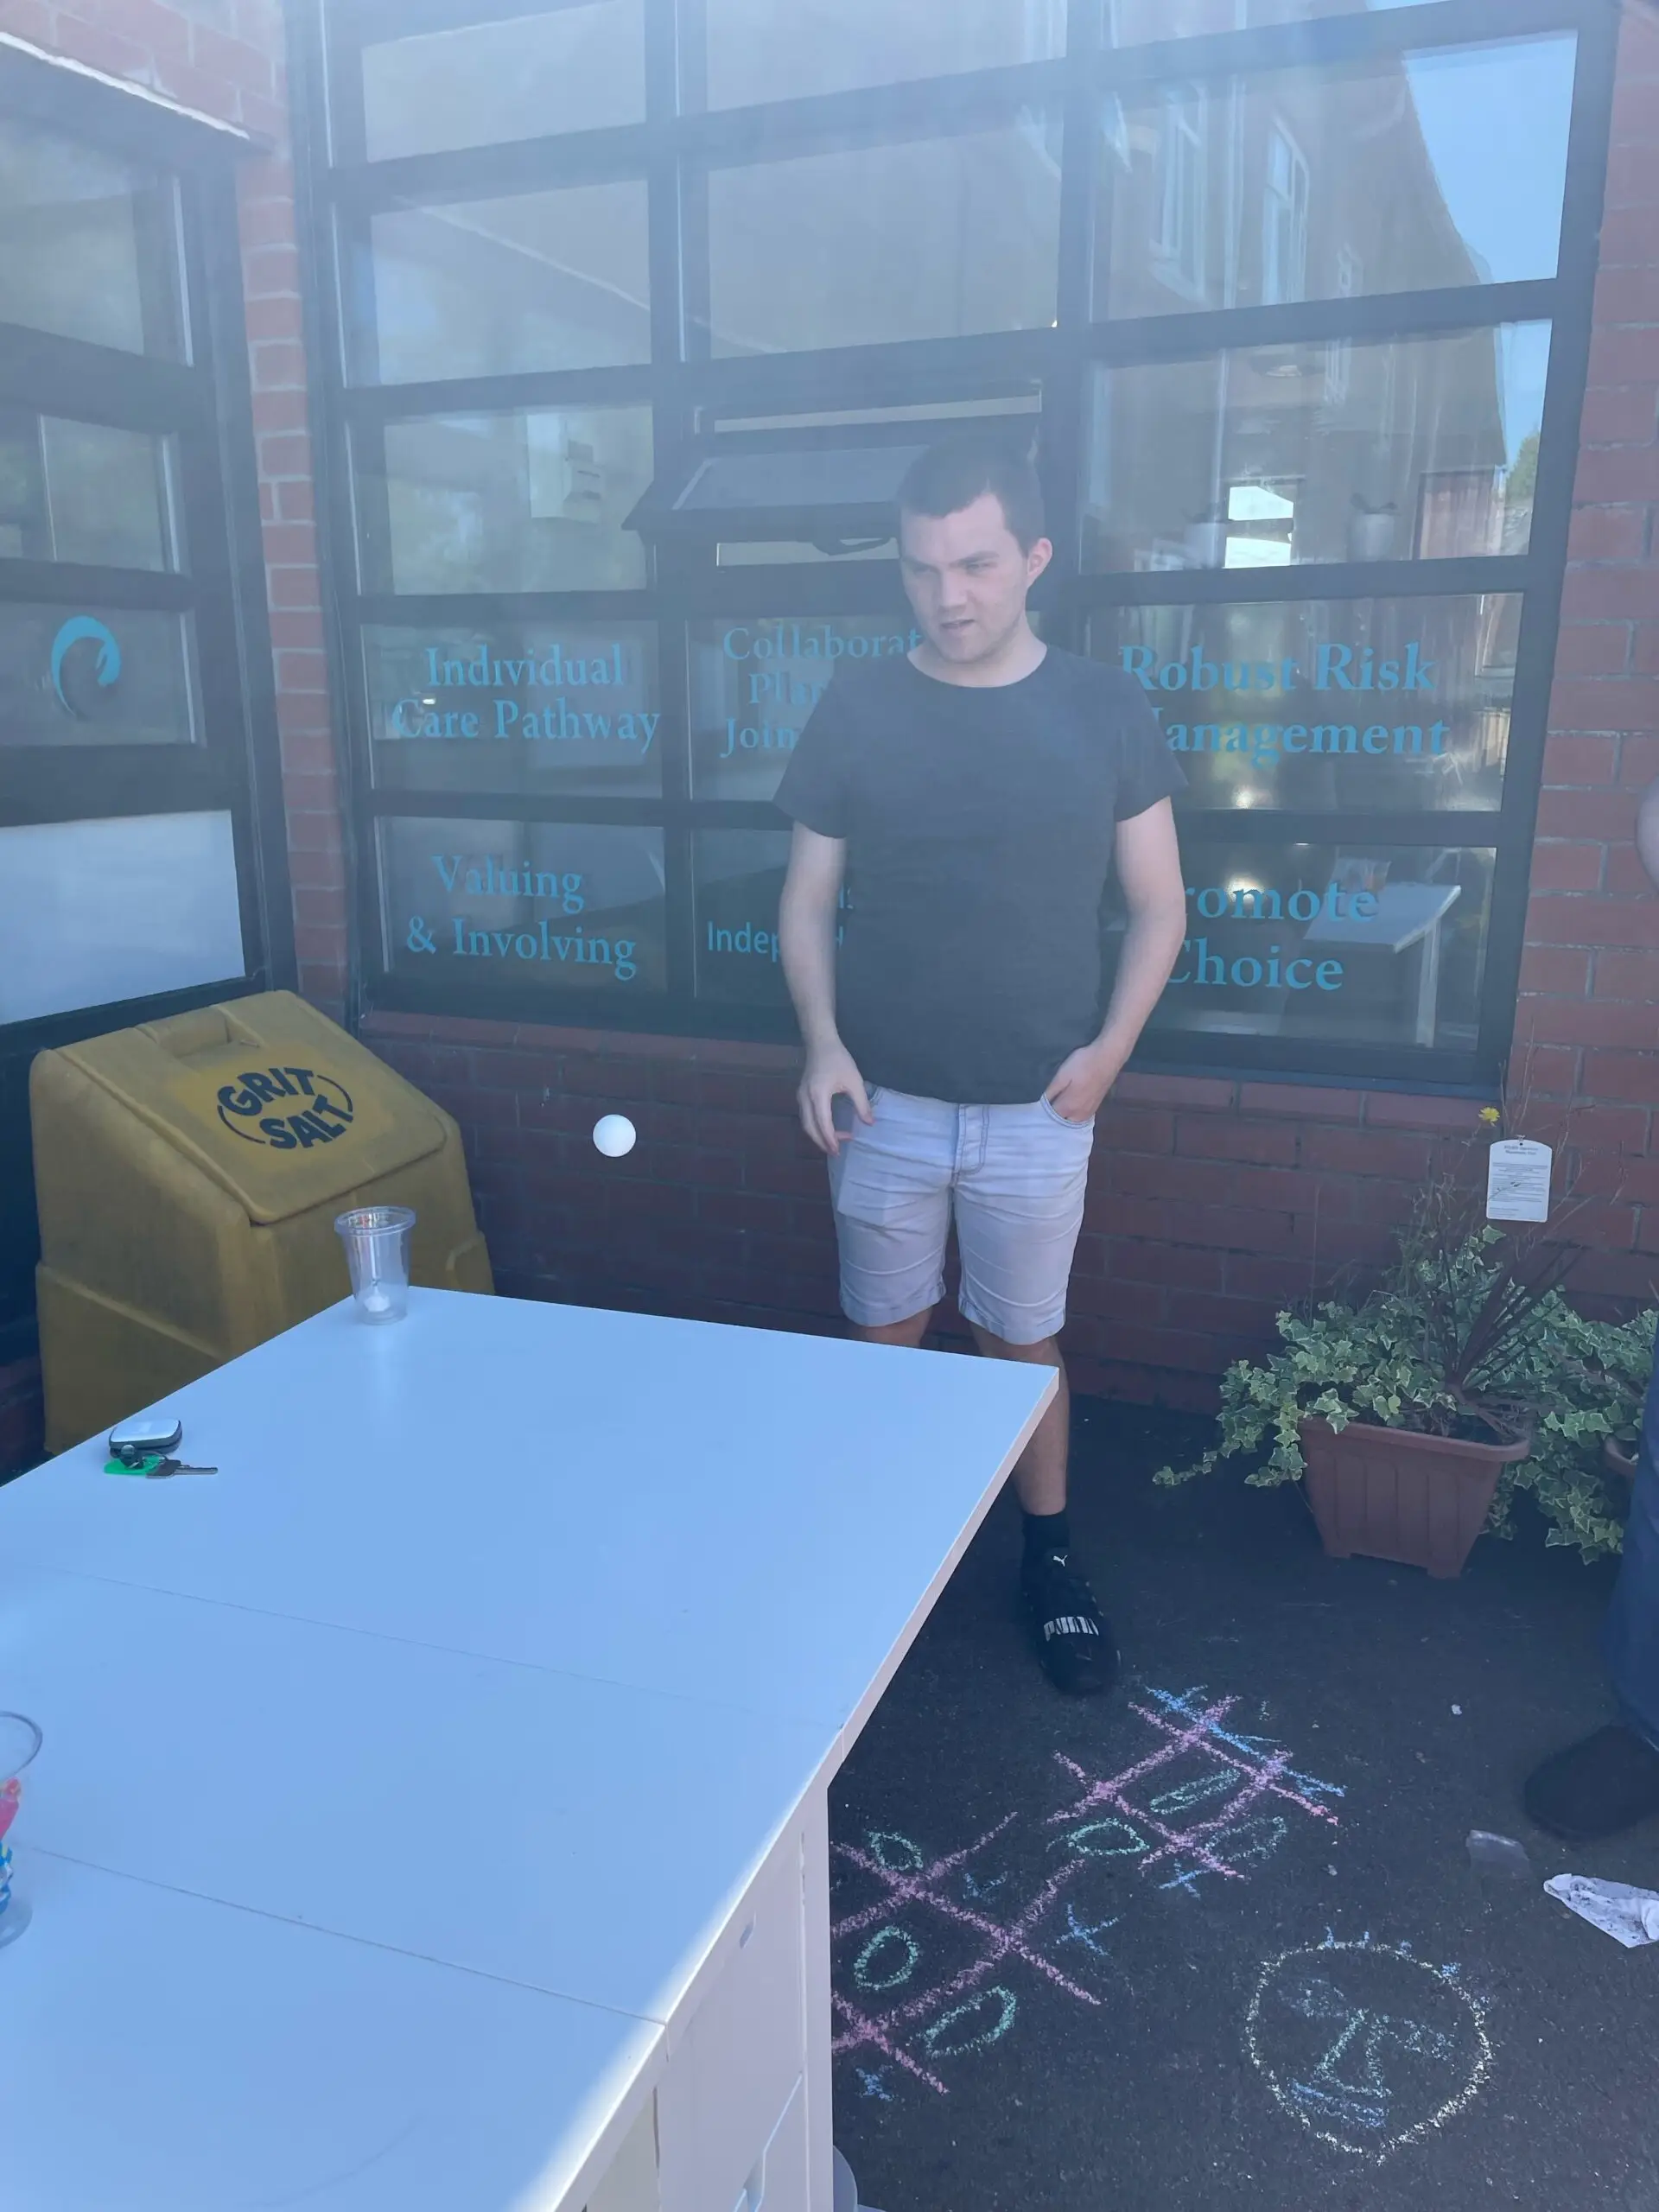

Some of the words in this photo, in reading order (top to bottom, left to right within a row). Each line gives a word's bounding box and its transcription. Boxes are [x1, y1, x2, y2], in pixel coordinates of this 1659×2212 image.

[426, 643, 624, 688] Individual
[723, 624, 923, 659] Collaborat
[1120, 643, 1300, 691] Robust
[1313, 642, 1438, 691] Risk
[391, 699, 480, 739] Care
[493, 697, 661, 754] Pathway
[720, 717, 800, 759] Join
[1152, 706, 1450, 770] anagement
[432, 854, 585, 915] Valuing
[406, 915, 436, 955] &
[453, 917, 638, 982] Involving
[217, 1066, 316, 1116] GRIT
[258, 1093, 354, 1149] SALT
